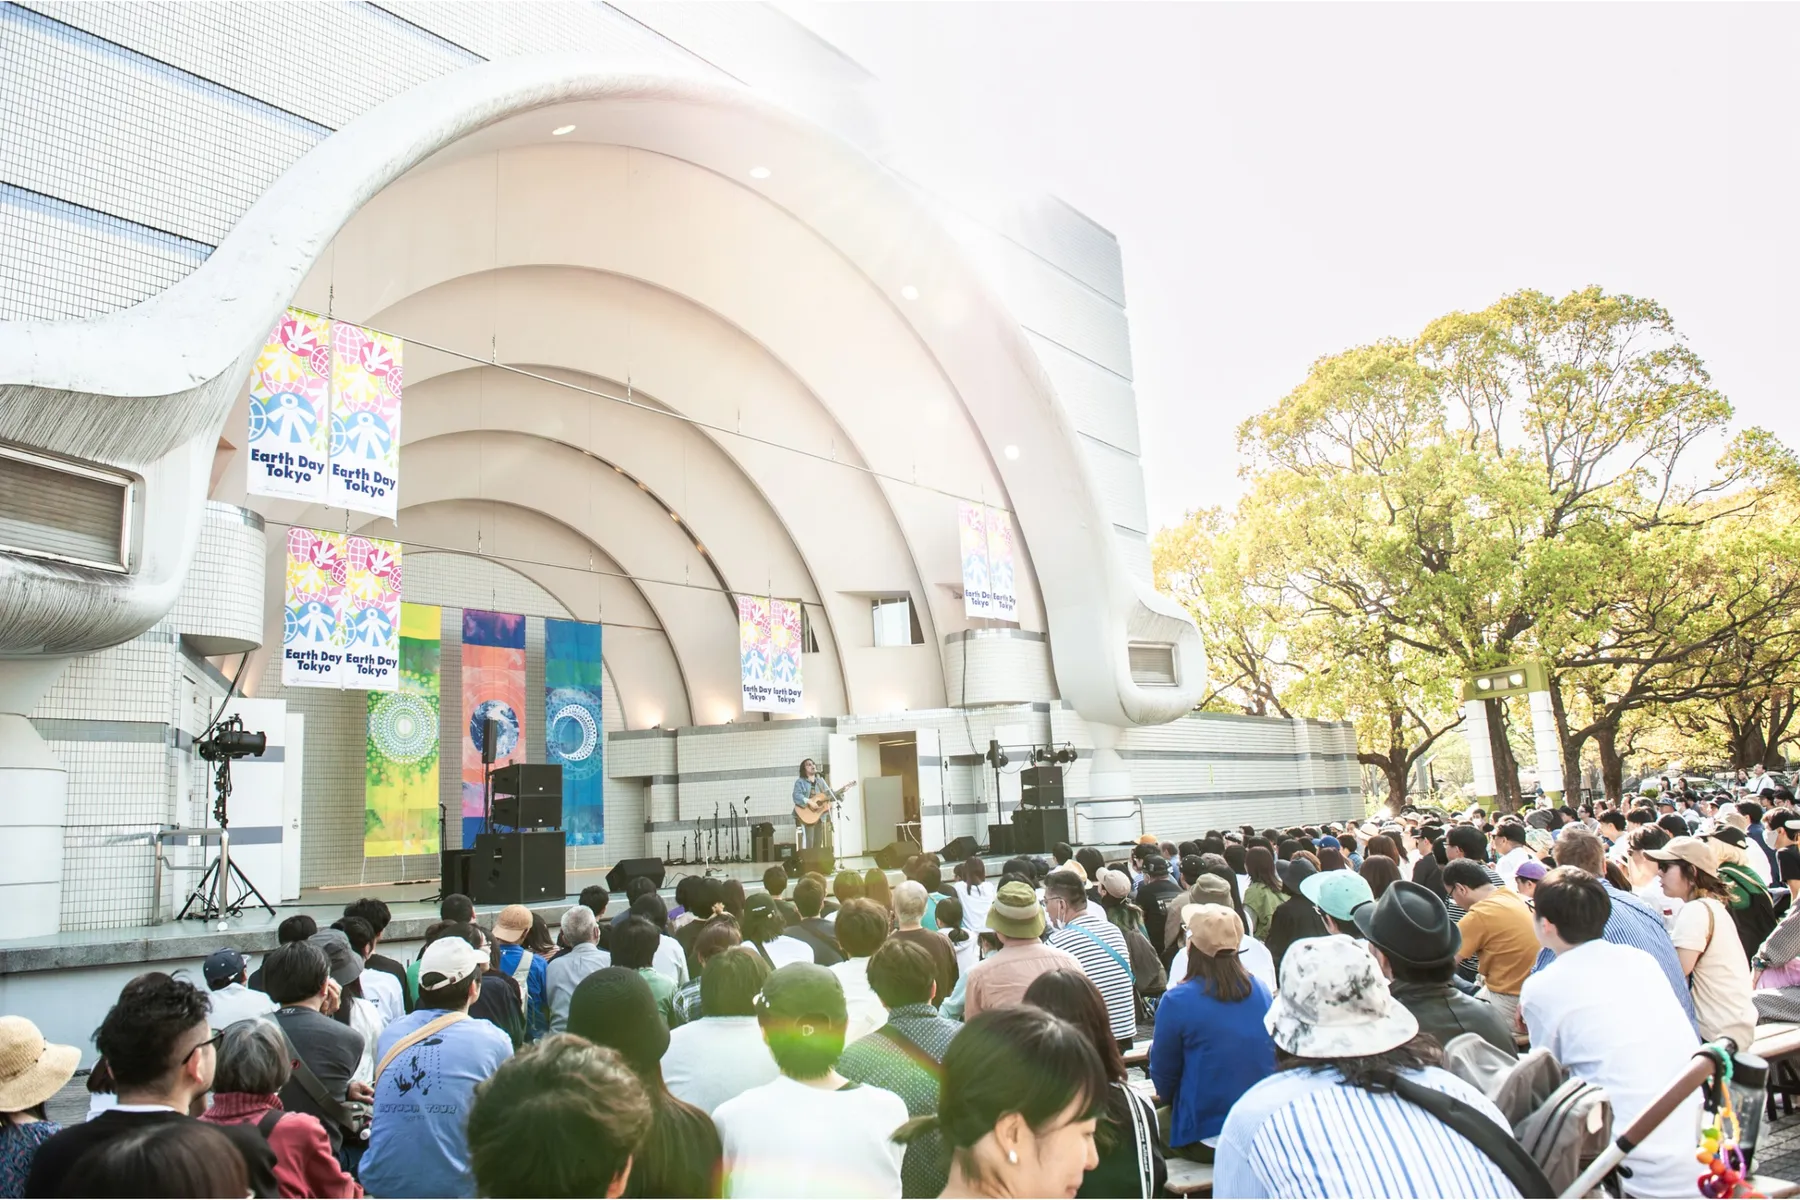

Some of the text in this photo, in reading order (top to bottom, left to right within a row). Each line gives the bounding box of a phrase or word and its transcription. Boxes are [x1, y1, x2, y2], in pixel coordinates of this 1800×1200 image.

[251, 448, 325, 474] Earth Day
[266, 463, 312, 483] Tokyo
[332, 463, 396, 490] Earth Day
[344, 479, 385, 498] Tokyo
[285, 648, 342, 665] Earth Day
[346, 653, 397, 669] Earth Day
[297, 660, 331, 674] Tokyo
[357, 664, 388, 678] Tokyo
[743, 684, 772, 695] Earth Day
[748, 692, 766, 702] Tokyo
[788, 688, 802, 698] Day
[777, 695, 796, 704] Tokyo
